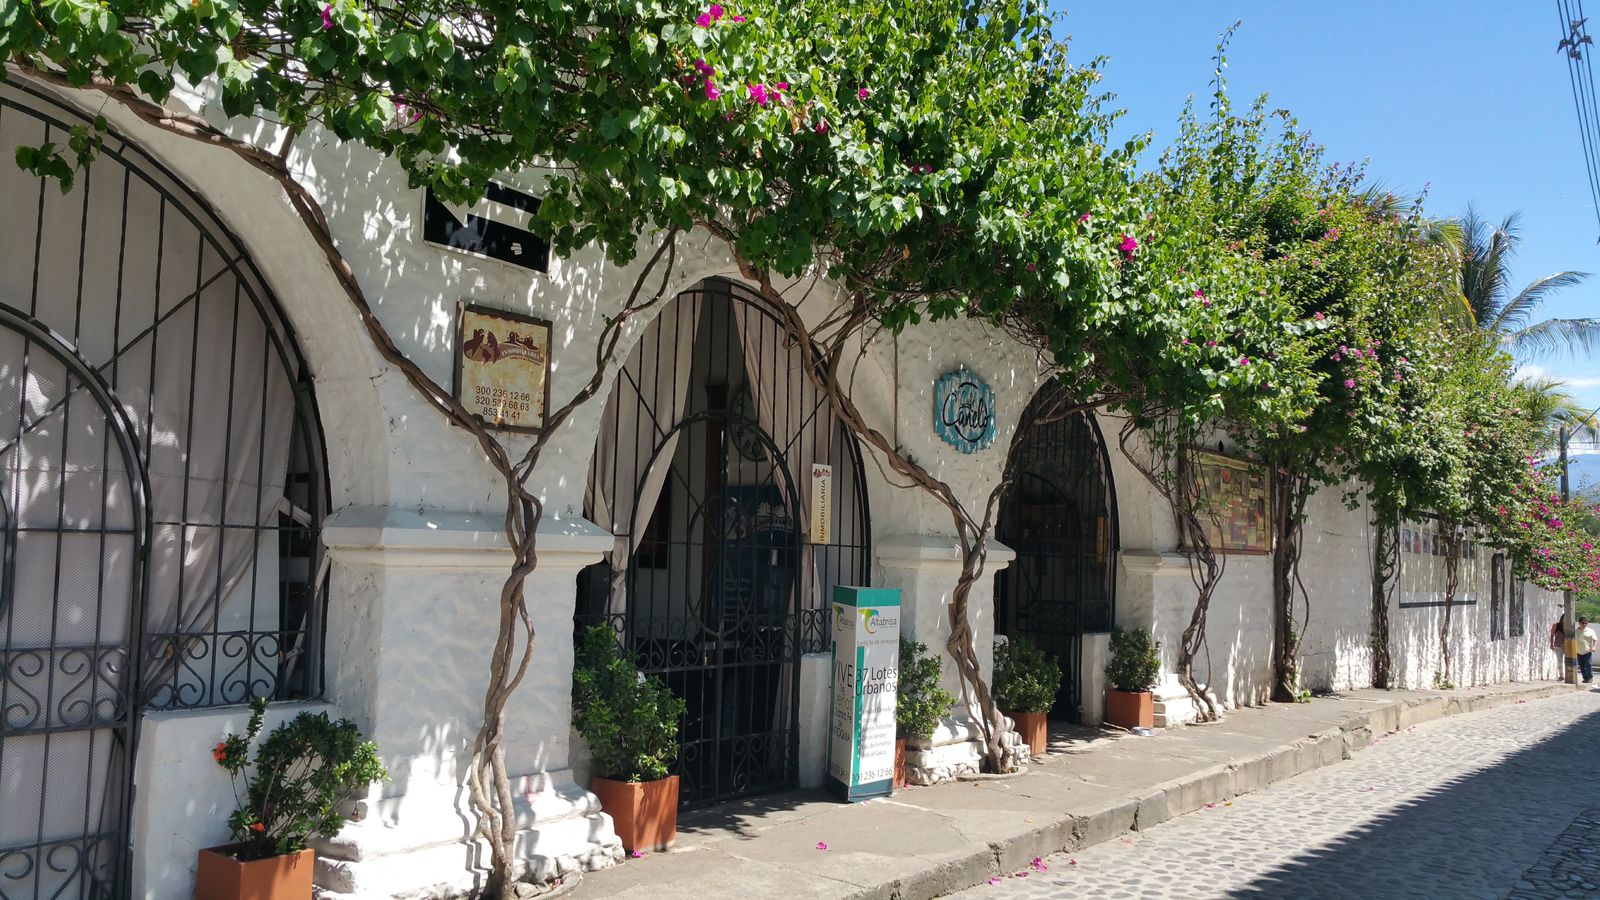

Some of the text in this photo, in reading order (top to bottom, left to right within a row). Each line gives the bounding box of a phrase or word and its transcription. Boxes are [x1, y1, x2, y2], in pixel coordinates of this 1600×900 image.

[475, 385, 530, 402] 300 236 12 66
[475, 396, 490, 406] 320
[492, 398, 507, 408] 539
[519, 401, 530, 412] 63
[942, 392, 991, 428] Canelo
[482, 407, 498, 417] 853
[511, 411, 521, 420] 41
[856, 666, 897, 682] 37 Lotes
[855, 680, 897, 696] Urbanos
[864, 770, 875, 780] 236
[877, 768, 885, 777] 12
[885, 766, 893, 776] 66
